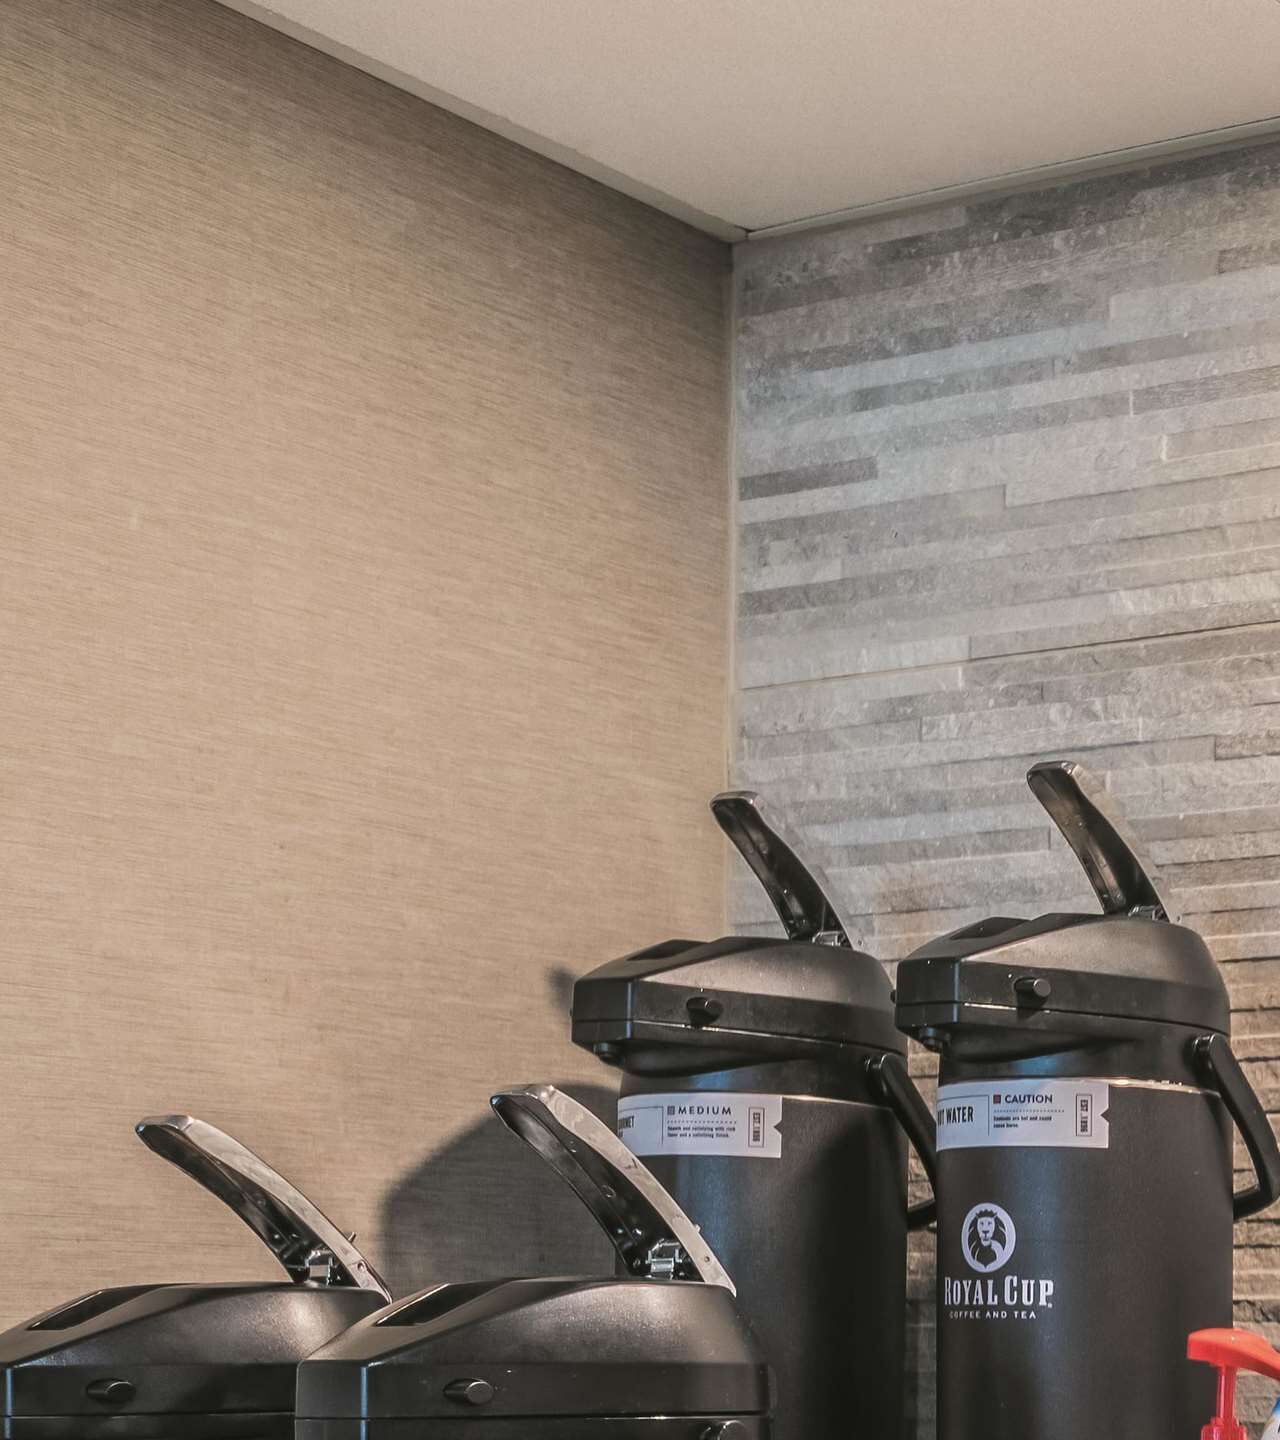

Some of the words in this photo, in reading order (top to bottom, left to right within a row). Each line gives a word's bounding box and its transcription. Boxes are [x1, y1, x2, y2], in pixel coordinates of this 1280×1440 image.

[1004, 1094, 1053, 1104] CAUTION
[678, 1105, 732, 1116] MEDIUM
[945, 1105, 974, 1126] WATER
[944, 1276, 998, 1306] ROYAL
[1004, 1275, 1054, 1306] CUP
[949, 1310, 981, 1319] COFFEE
[985, 1310, 1008, 1319] AND
[1013, 1310, 1037, 1319] TEA
